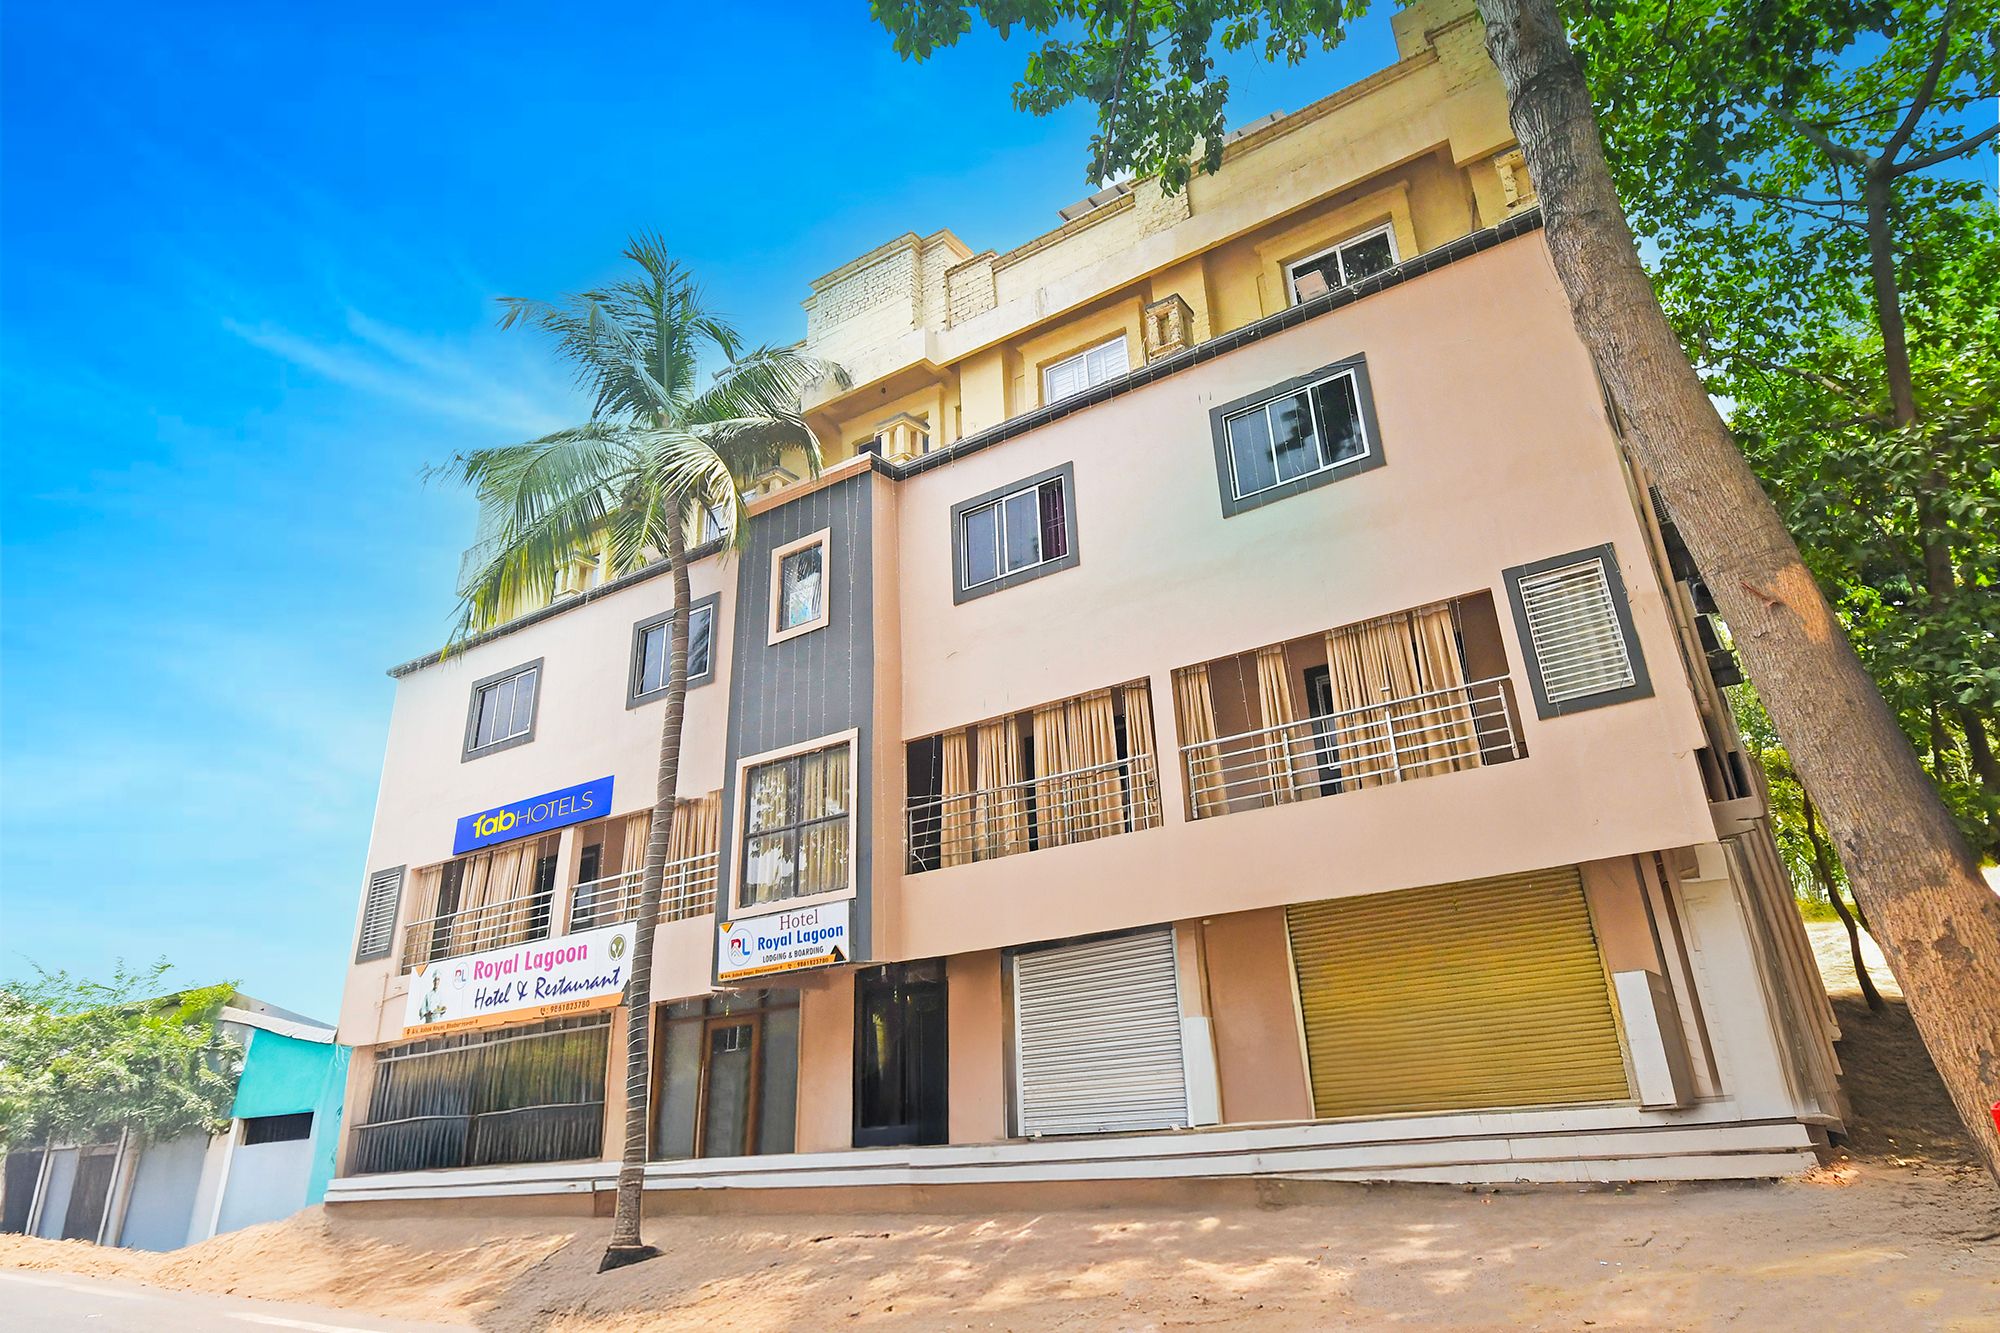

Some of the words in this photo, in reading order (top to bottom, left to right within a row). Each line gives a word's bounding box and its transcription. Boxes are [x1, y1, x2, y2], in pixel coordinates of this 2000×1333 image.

[473, 790, 593, 839] fabHOTELS
[780, 909, 819, 931] Hotel
[757, 931, 792, 951] Royal
[797, 925, 844, 945] Lagoon
[473, 953, 519, 981] Royal
[525, 944, 588, 972] Lagoon
[762, 952, 787, 964] LODGING
[788, 951, 793, 959] &
[794, 945, 824, 958] BOARDING
[474, 982, 512, 1010] Hotel
[517, 980, 528, 1001] &
[534, 966, 621, 1000] Restaurant
